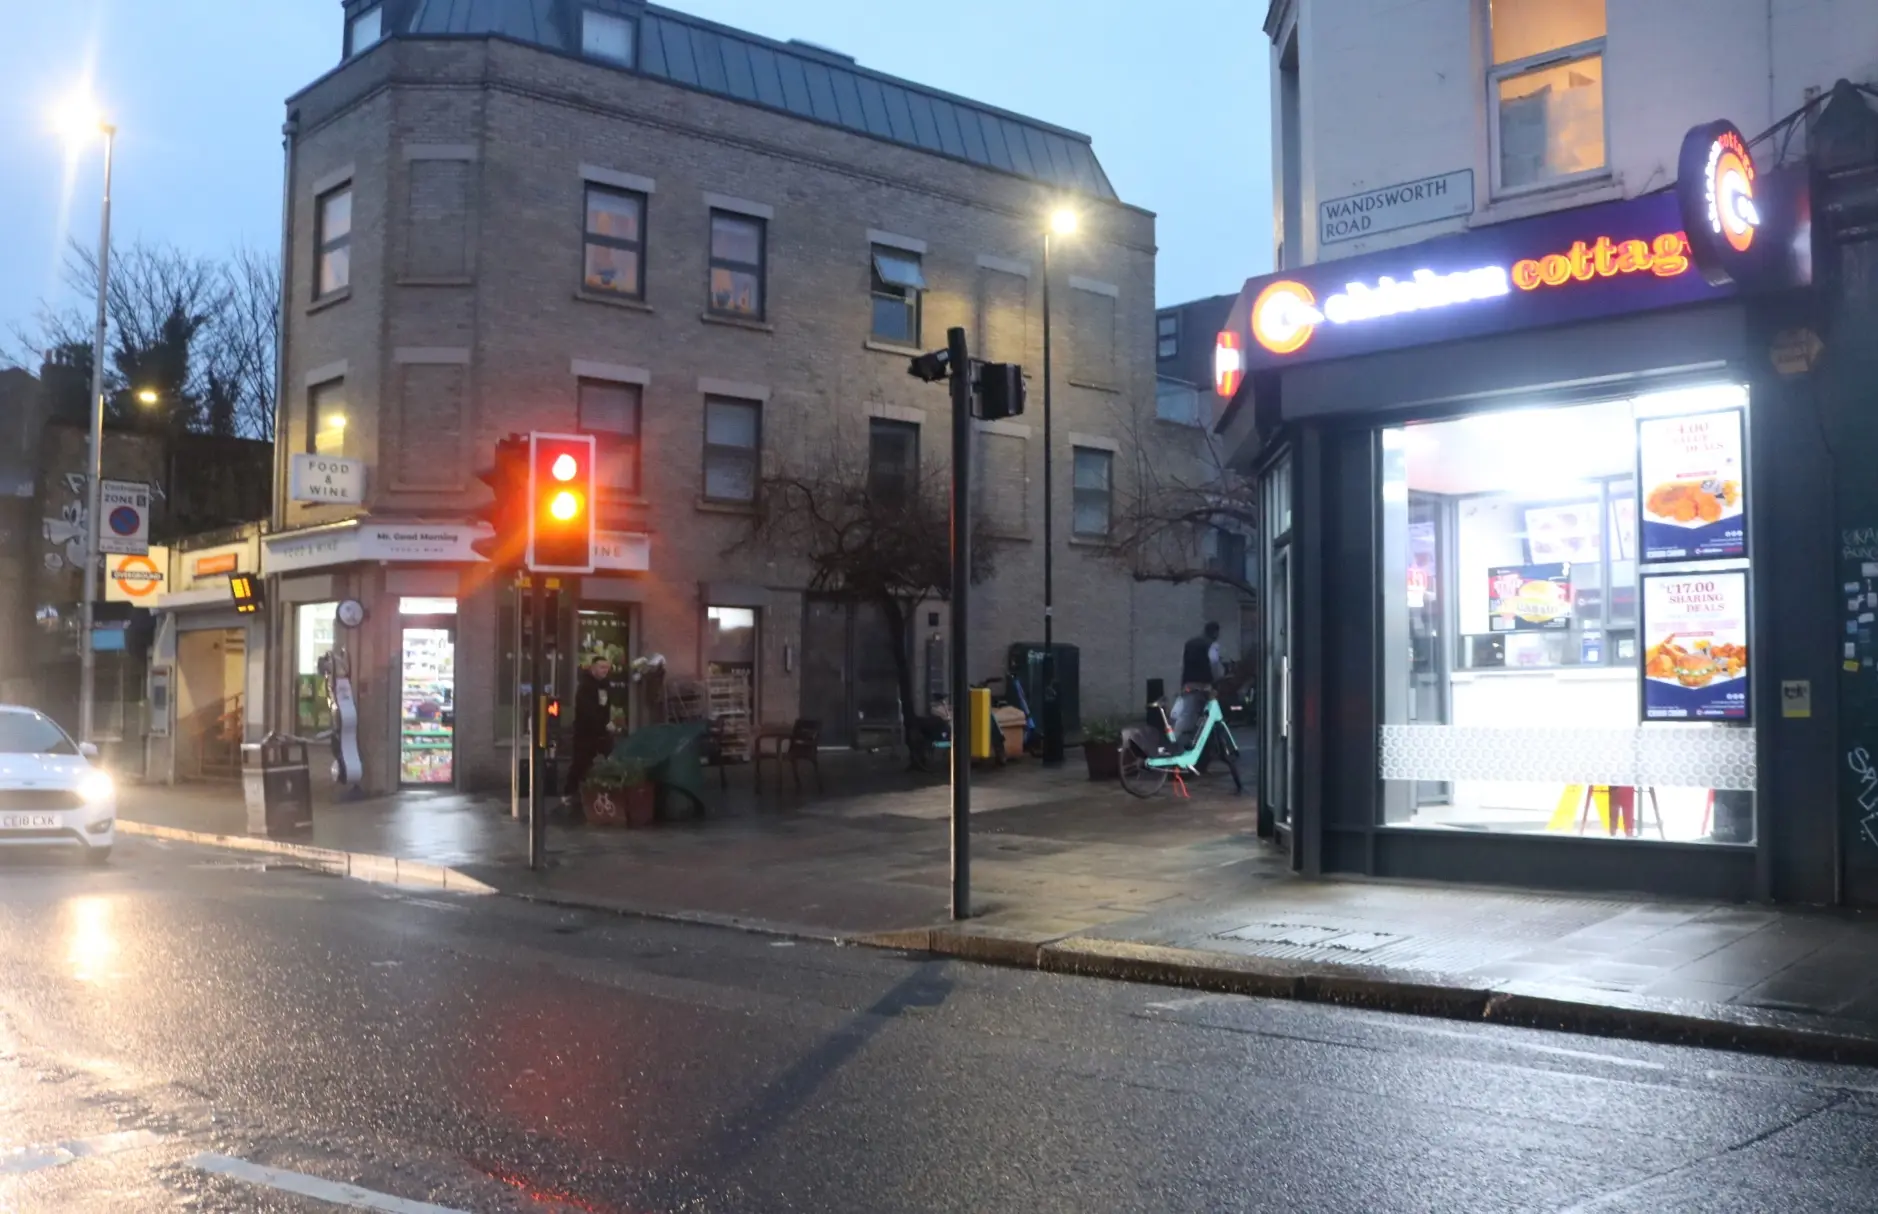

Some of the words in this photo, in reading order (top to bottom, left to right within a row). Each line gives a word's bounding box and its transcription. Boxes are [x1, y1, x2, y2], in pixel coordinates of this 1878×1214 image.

[1326, 179, 1447, 220] WANDSWORTH
[1326, 214, 1372, 239] ROAD
[1511, 230, 1692, 291] cottag
[308, 459, 349, 474] FOOD
[324, 473, 332, 485] &
[309, 484, 349, 498] WINE
[104, 493, 134, 504] ZONE
[377, 532, 391, 541] Mr.
[393, 532, 418, 542] Good
[420, 532, 459, 544] Morning
[594, 545, 622, 558] INE
[1667, 581, 1715, 594] £17.00
[1668, 593, 1724, 605] SHARING
[1686, 602, 1726, 613] DEALS
